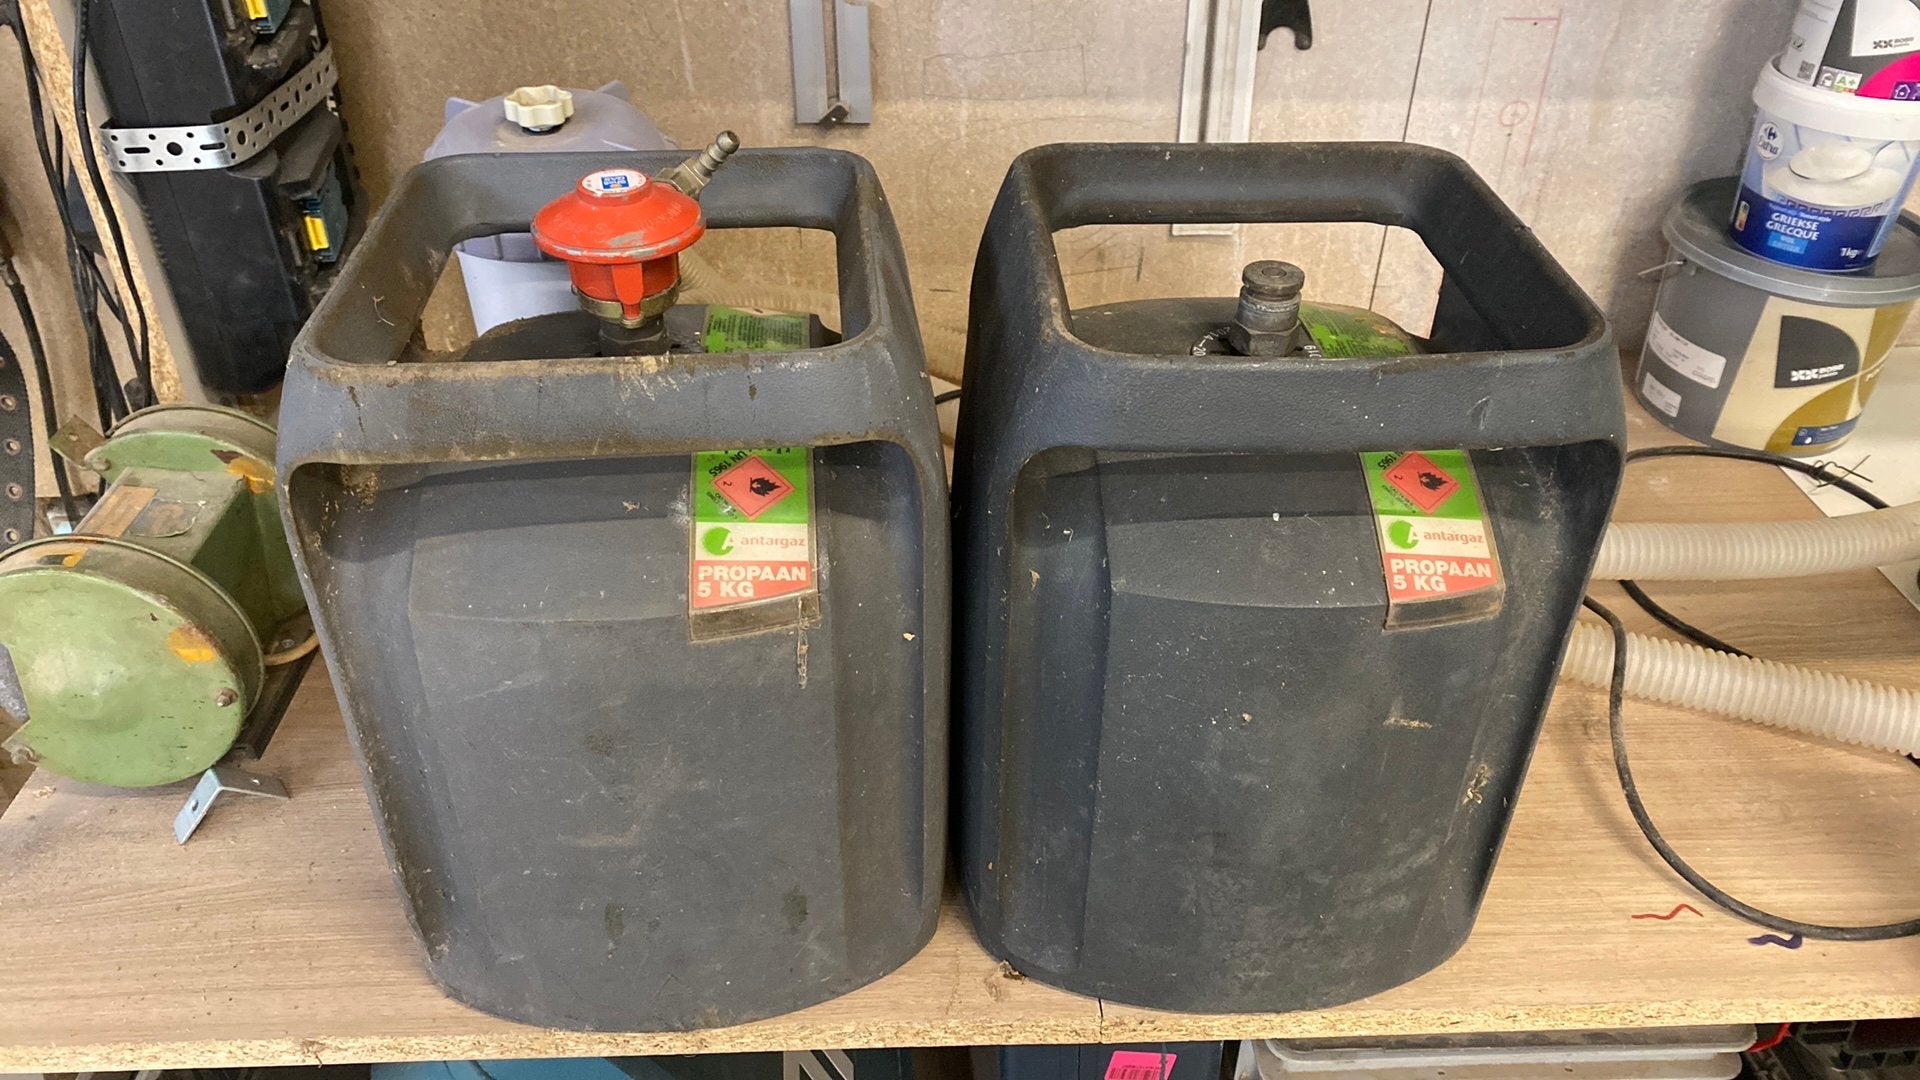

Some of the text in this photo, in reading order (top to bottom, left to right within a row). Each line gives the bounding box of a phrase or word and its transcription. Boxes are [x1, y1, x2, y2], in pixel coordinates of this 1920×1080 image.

[1837, 75, 1857, 87] A+
[1771, 211, 1820, 231] GRIEKSE
[1766, 220, 1820, 241] GRECQUE
[729, 449, 748, 463] UN
[1377, 453, 1397, 471] 1965
[708, 460, 732, 478] 1965
[740, 536, 807, 549] antargaz
[1423, 530, 1484, 545] antargaz
[698, 565, 807, 582] PROPAAN
[1390, 558, 1493, 579] PROPAAN
[697, 581, 755, 598] 5 KG
[1392, 574, 1448, 593] 5 KG
